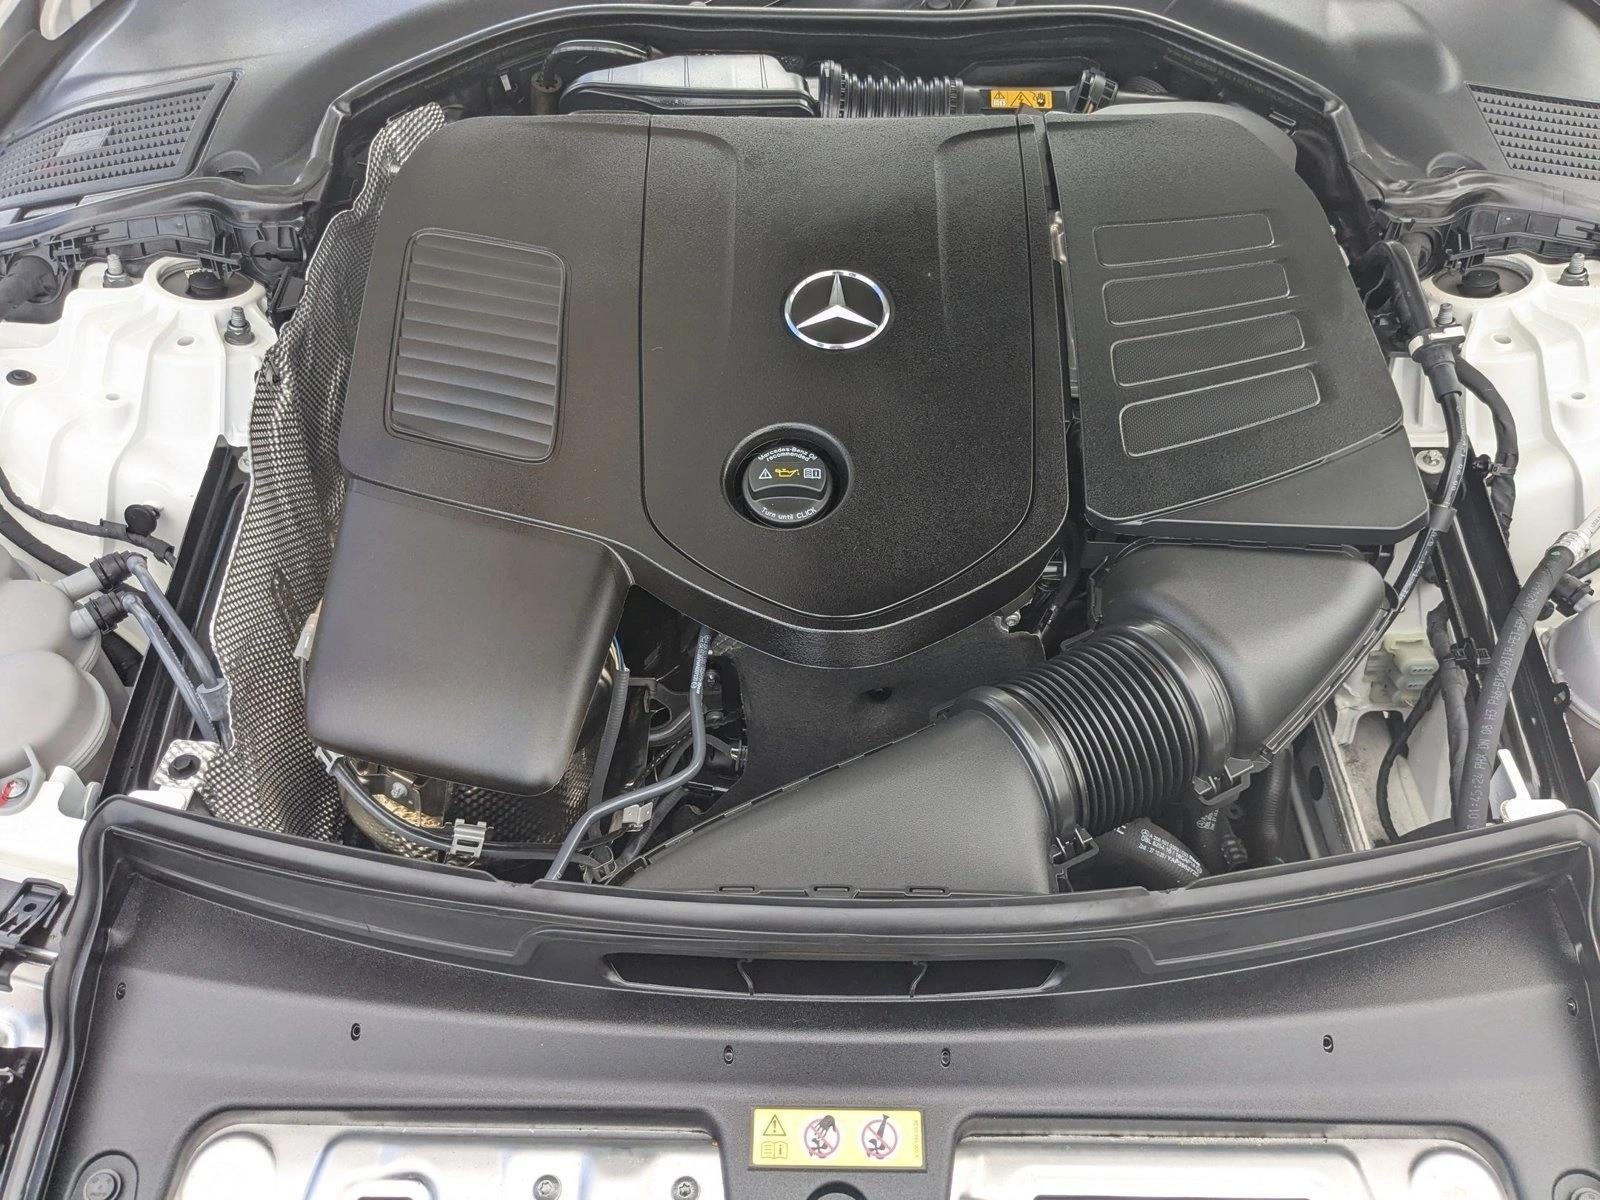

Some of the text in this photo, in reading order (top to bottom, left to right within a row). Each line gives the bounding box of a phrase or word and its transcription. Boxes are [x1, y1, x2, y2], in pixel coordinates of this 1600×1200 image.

[758, 446, 807, 460] Mercedes-Benz
[766, 452, 810, 462] recommended
[761, 506, 776, 518] Turn
[796, 506, 817, 519] CLICK
